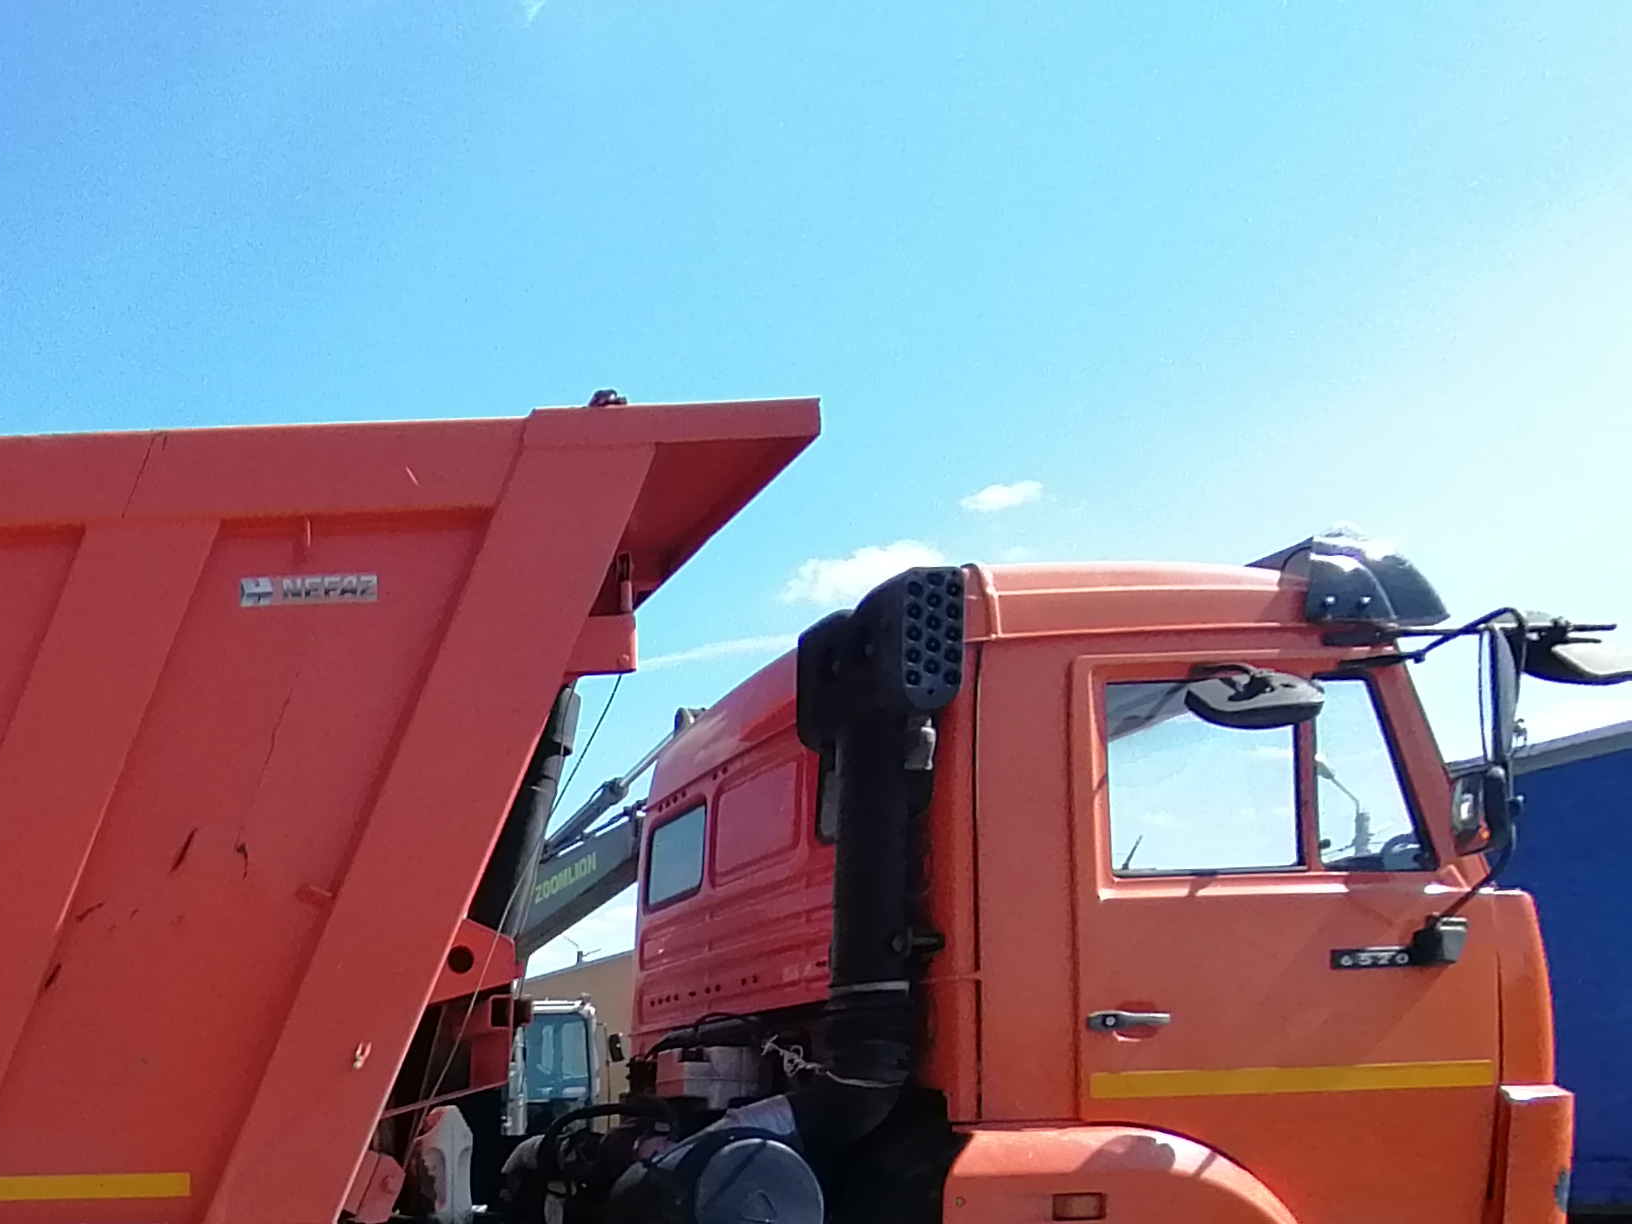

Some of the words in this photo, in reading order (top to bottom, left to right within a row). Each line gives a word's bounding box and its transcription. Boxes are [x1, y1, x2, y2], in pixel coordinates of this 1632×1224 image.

[283, 574, 377, 599] NEFAZ
[534, 852, 597, 904] ZOOMLION
[1340, 951, 1409, 967] 6520
